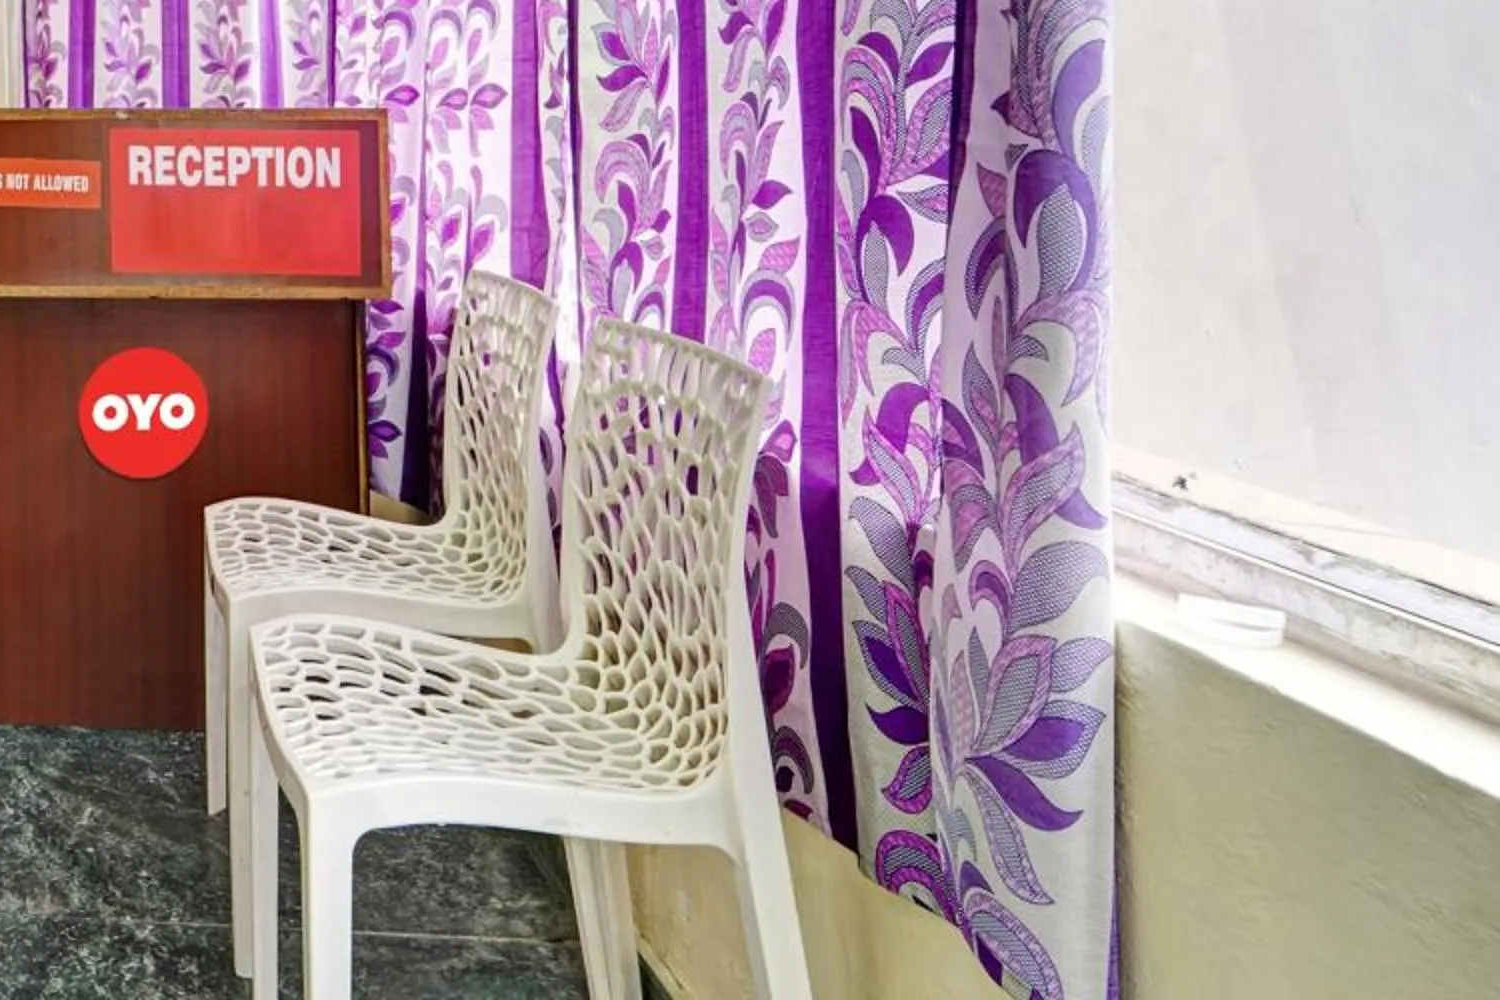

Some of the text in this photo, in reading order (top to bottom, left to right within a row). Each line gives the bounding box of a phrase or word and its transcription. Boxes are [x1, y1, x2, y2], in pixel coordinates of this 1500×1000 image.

[5, 173, 29, 191] NOT
[33, 174, 89, 193] ALLOWED
[128, 145, 341, 188] RECEPTION
[92, 392, 196, 432] OYO
